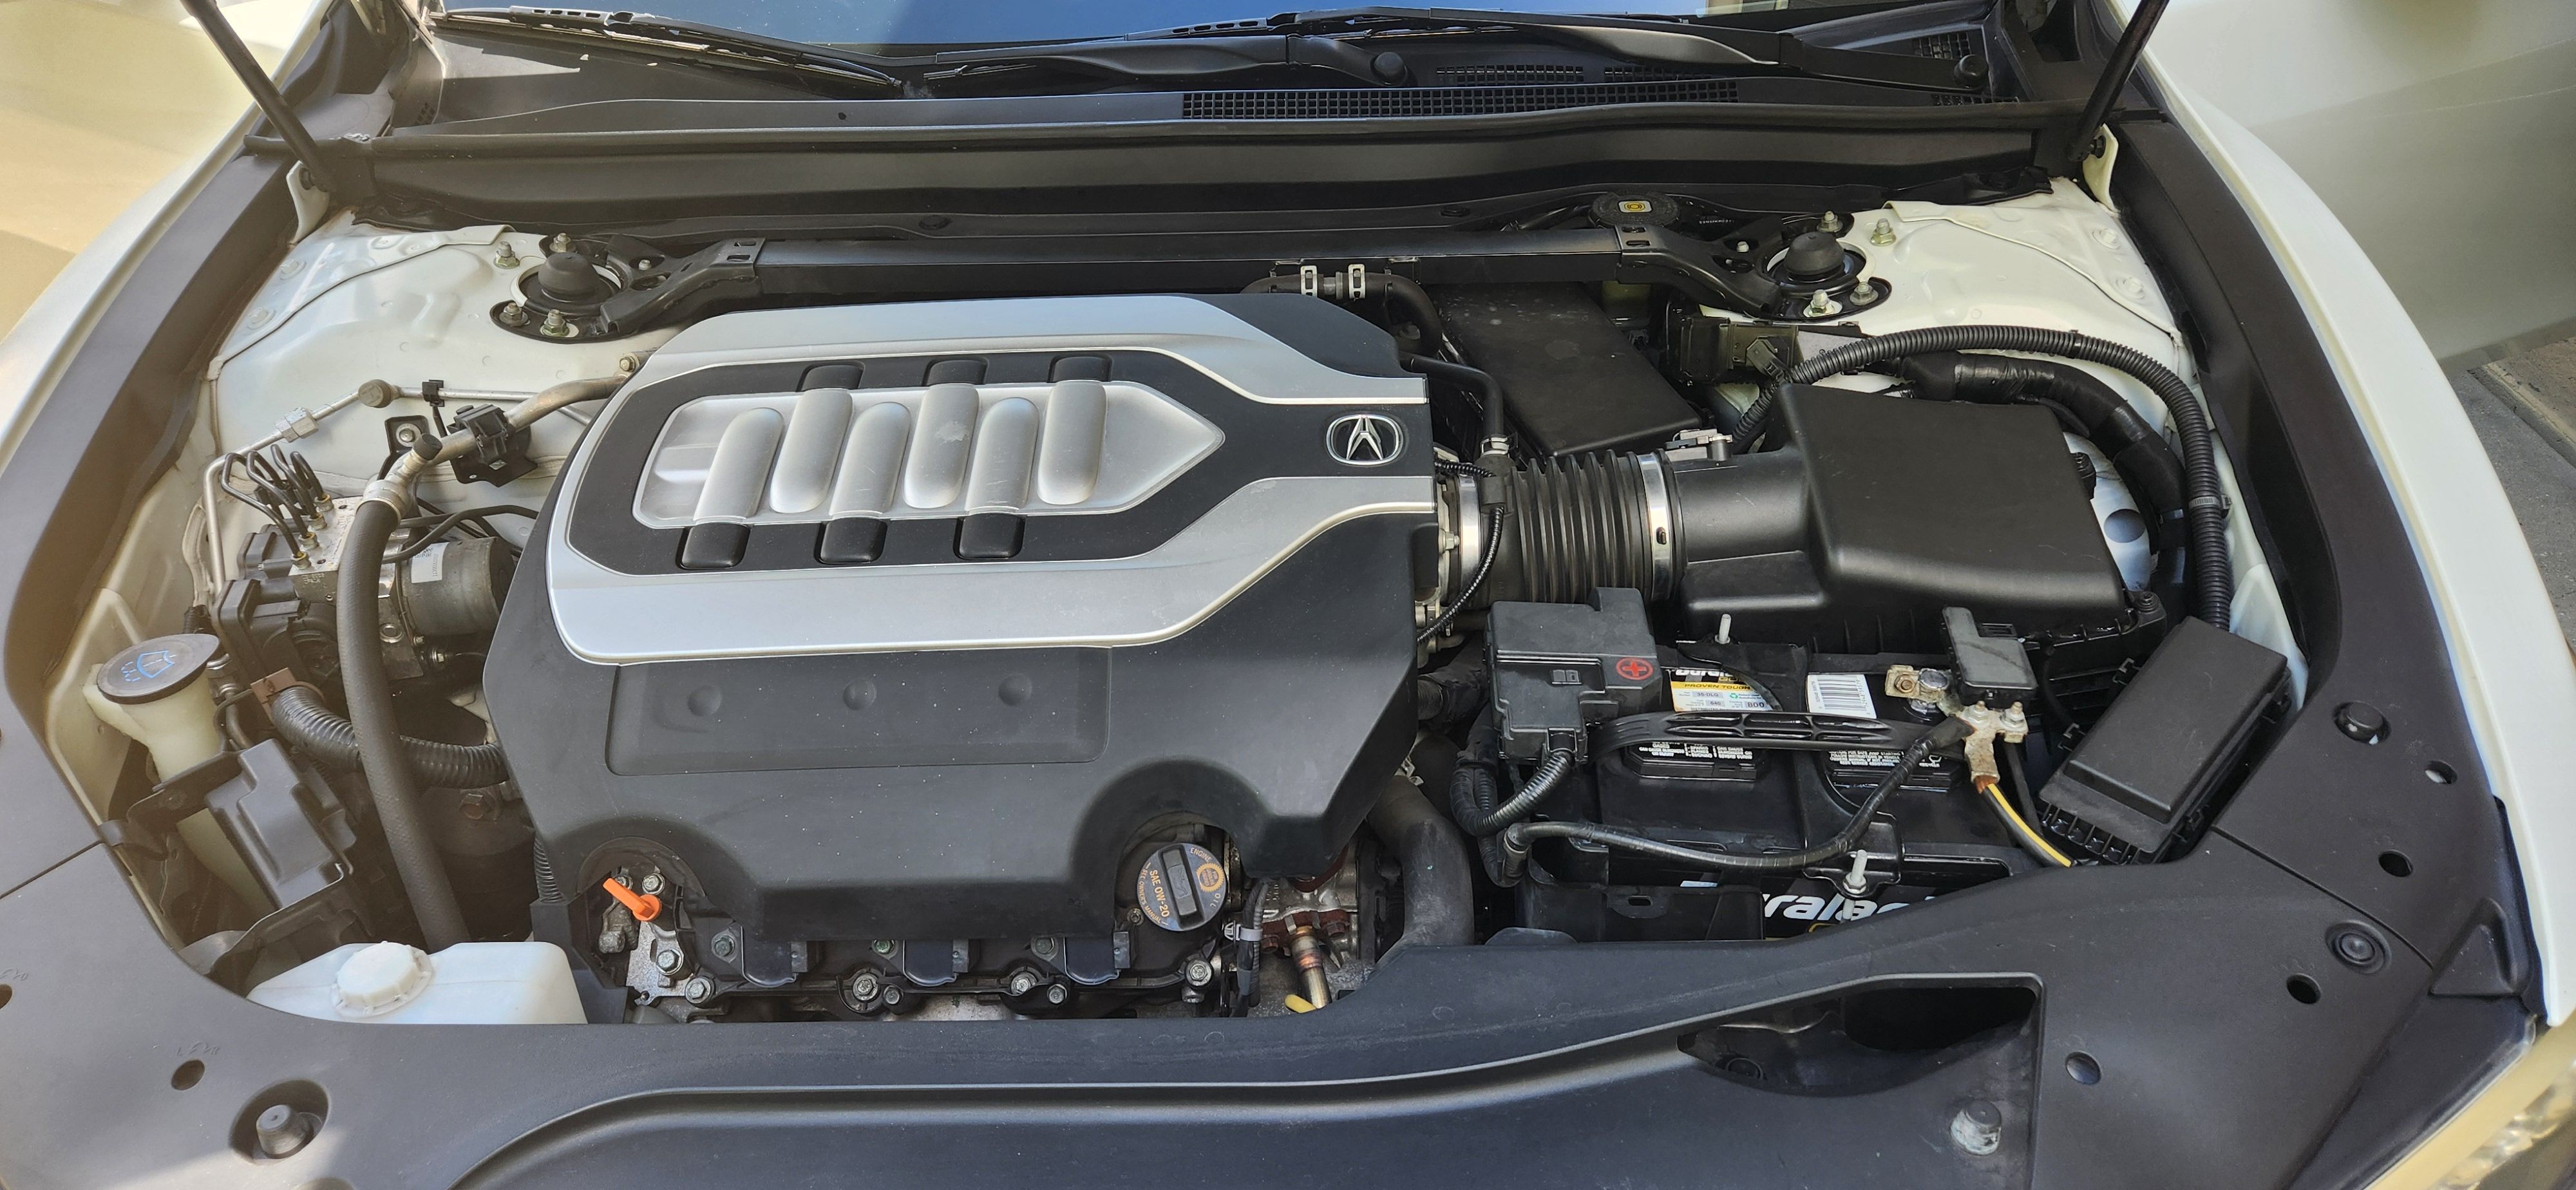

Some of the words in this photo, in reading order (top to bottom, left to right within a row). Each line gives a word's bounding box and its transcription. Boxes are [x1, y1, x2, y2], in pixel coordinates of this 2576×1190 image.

[1190, 847, 1212, 862] ENGINE
[1150, 869, 1160, 886] SAE
[1138, 881, 1146, 905] OWNER'S
[1144, 905, 1161, 924] MANUAL
[1154, 887, 1170, 918] 0W-20
[1209, 893, 1221, 907] OIL
